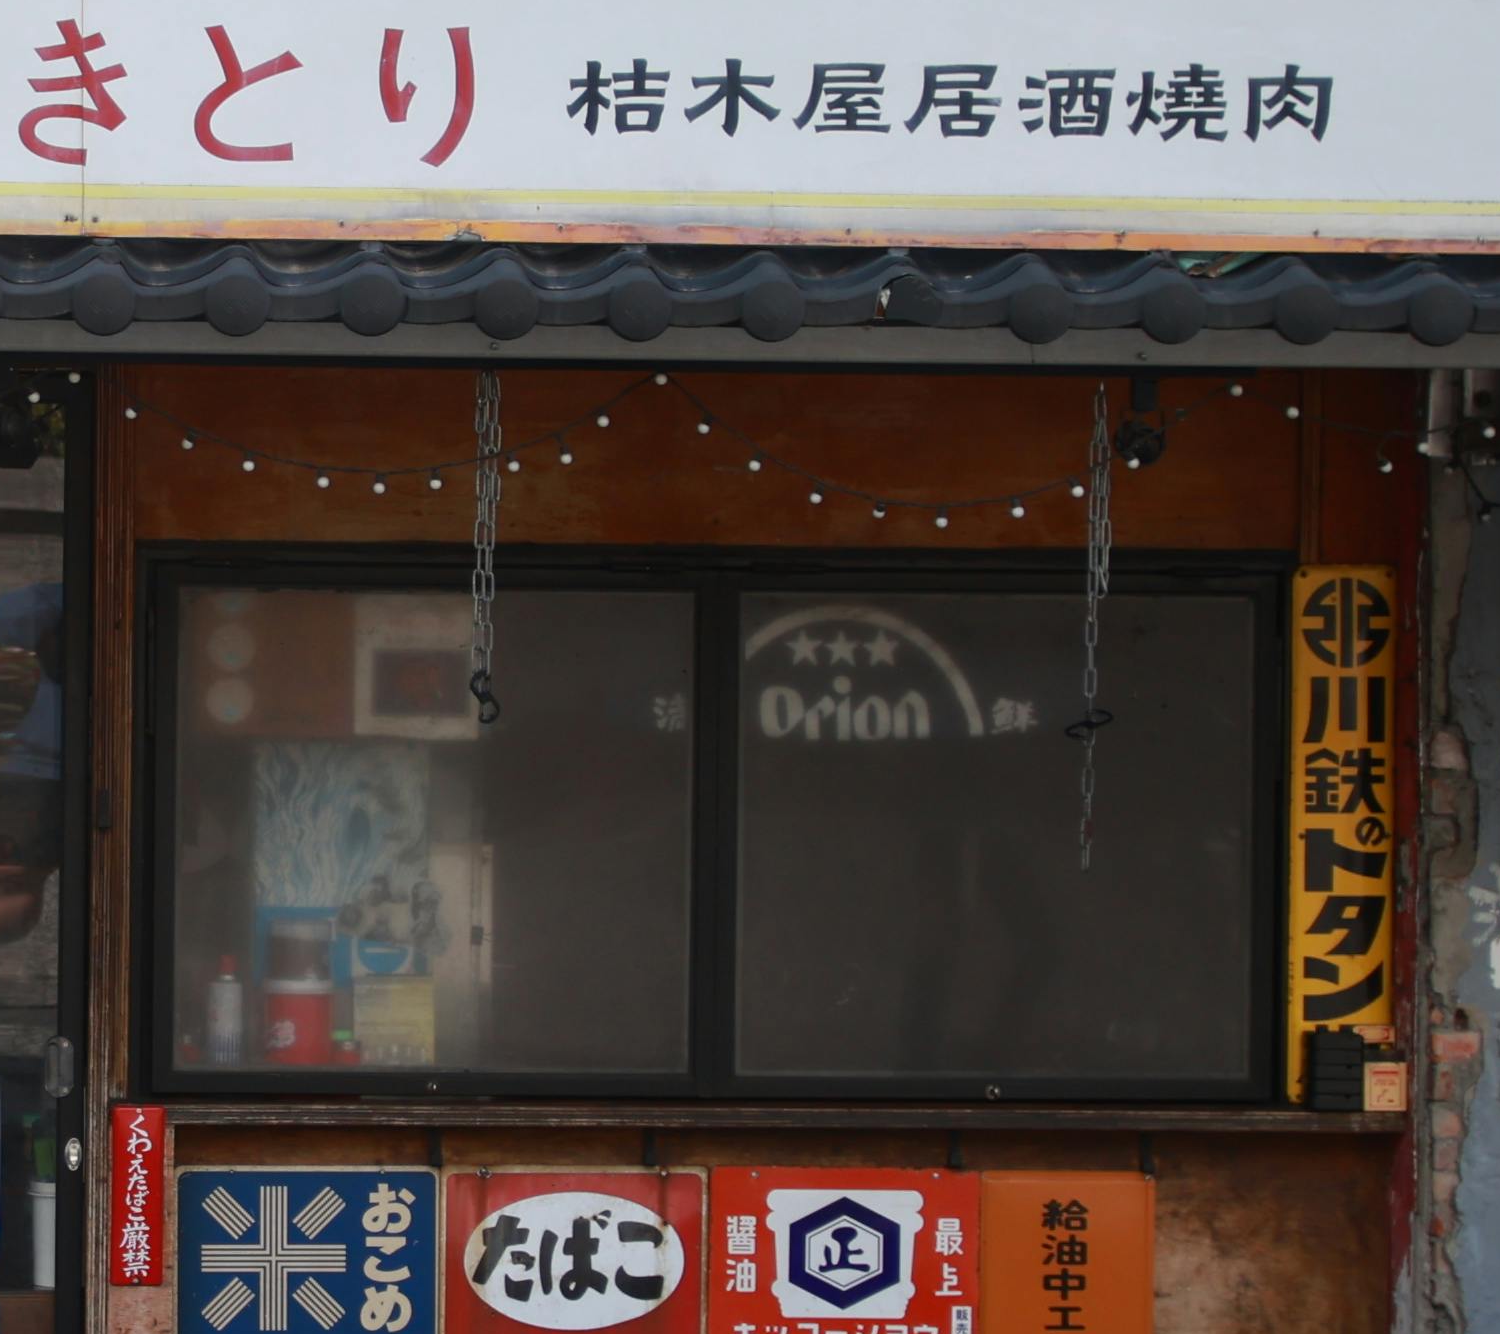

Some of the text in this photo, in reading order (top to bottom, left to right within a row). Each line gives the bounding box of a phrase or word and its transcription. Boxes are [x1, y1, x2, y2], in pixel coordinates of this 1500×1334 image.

[566, 59, 1336, 145] 桔木屋居酒燒肉
[759, 675, 931, 741] Orion
[119, 1114, 152, 1278] くわえたばこ厳禁
[359, 1182, 417, 1333] おこめ
[471, 1209, 666, 1302] たばこ
[935, 1217, 963, 1296] 最上
